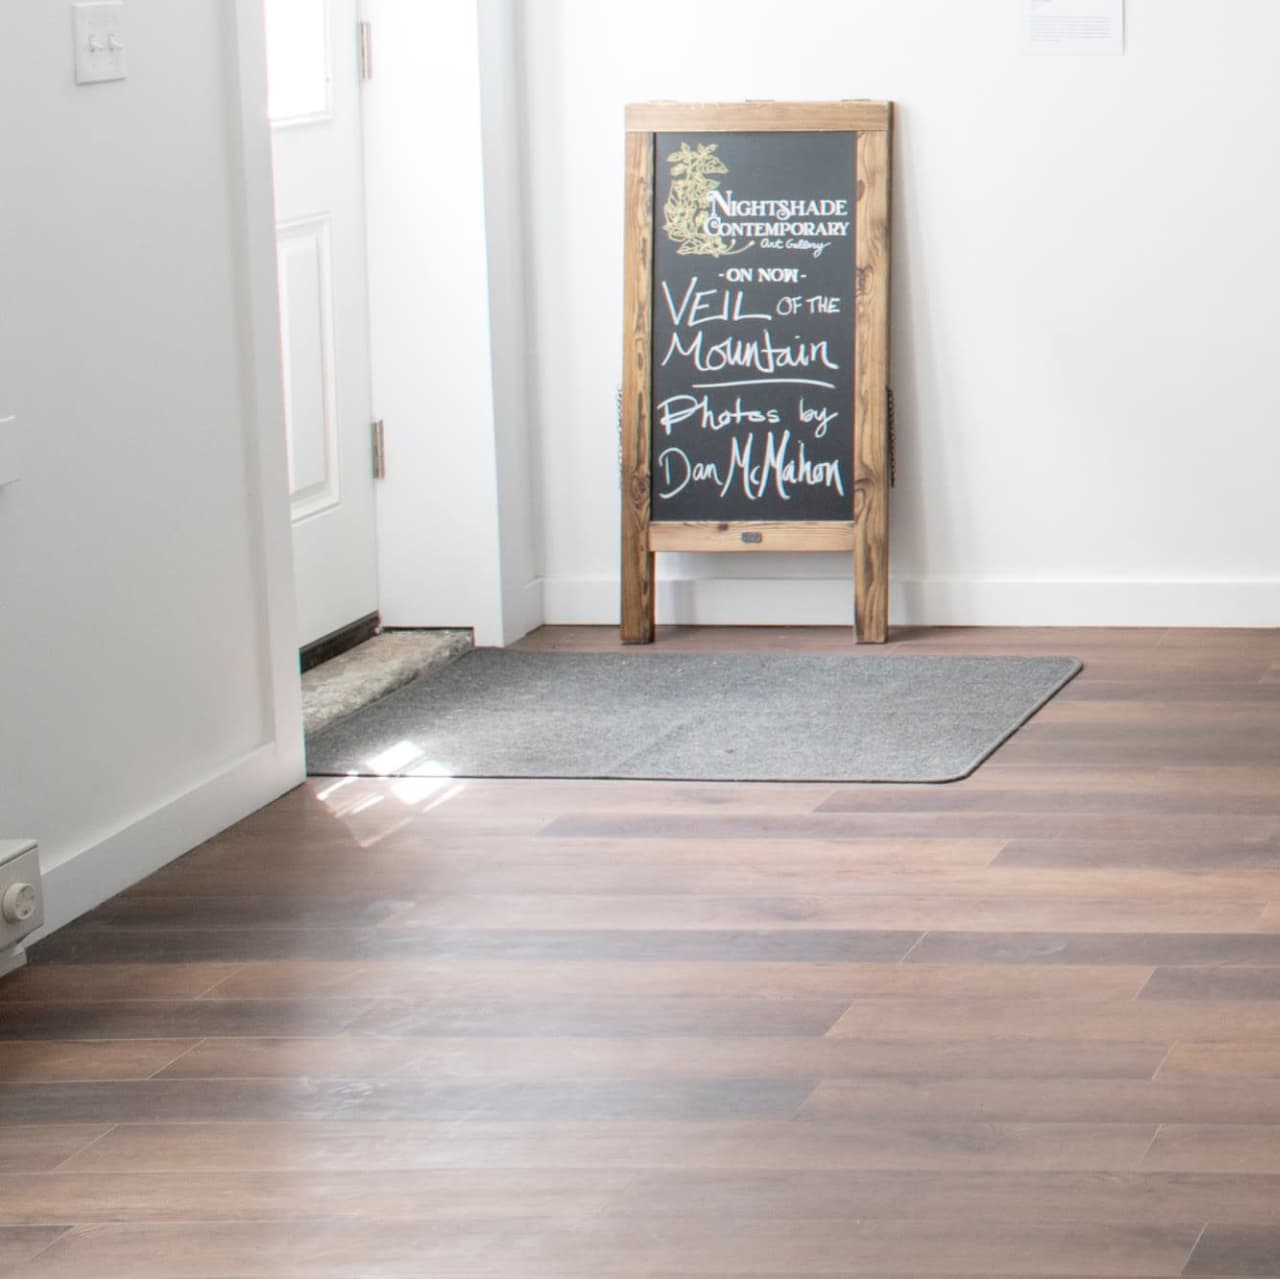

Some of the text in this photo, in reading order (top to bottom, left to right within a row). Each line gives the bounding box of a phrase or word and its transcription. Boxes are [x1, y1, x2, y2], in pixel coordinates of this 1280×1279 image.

[703, 216, 850, 237] CONTEMPORARY
[706, 190, 848, 220] NIGHTSHADE
[760, 239, 785, 249] Art
[662, 276, 840, 327] VEIL OF THE
[661, 328, 839, 373] Mountain
[657, 394, 839, 438] Photos by
[658, 429, 844, 500] Dan McMahon
